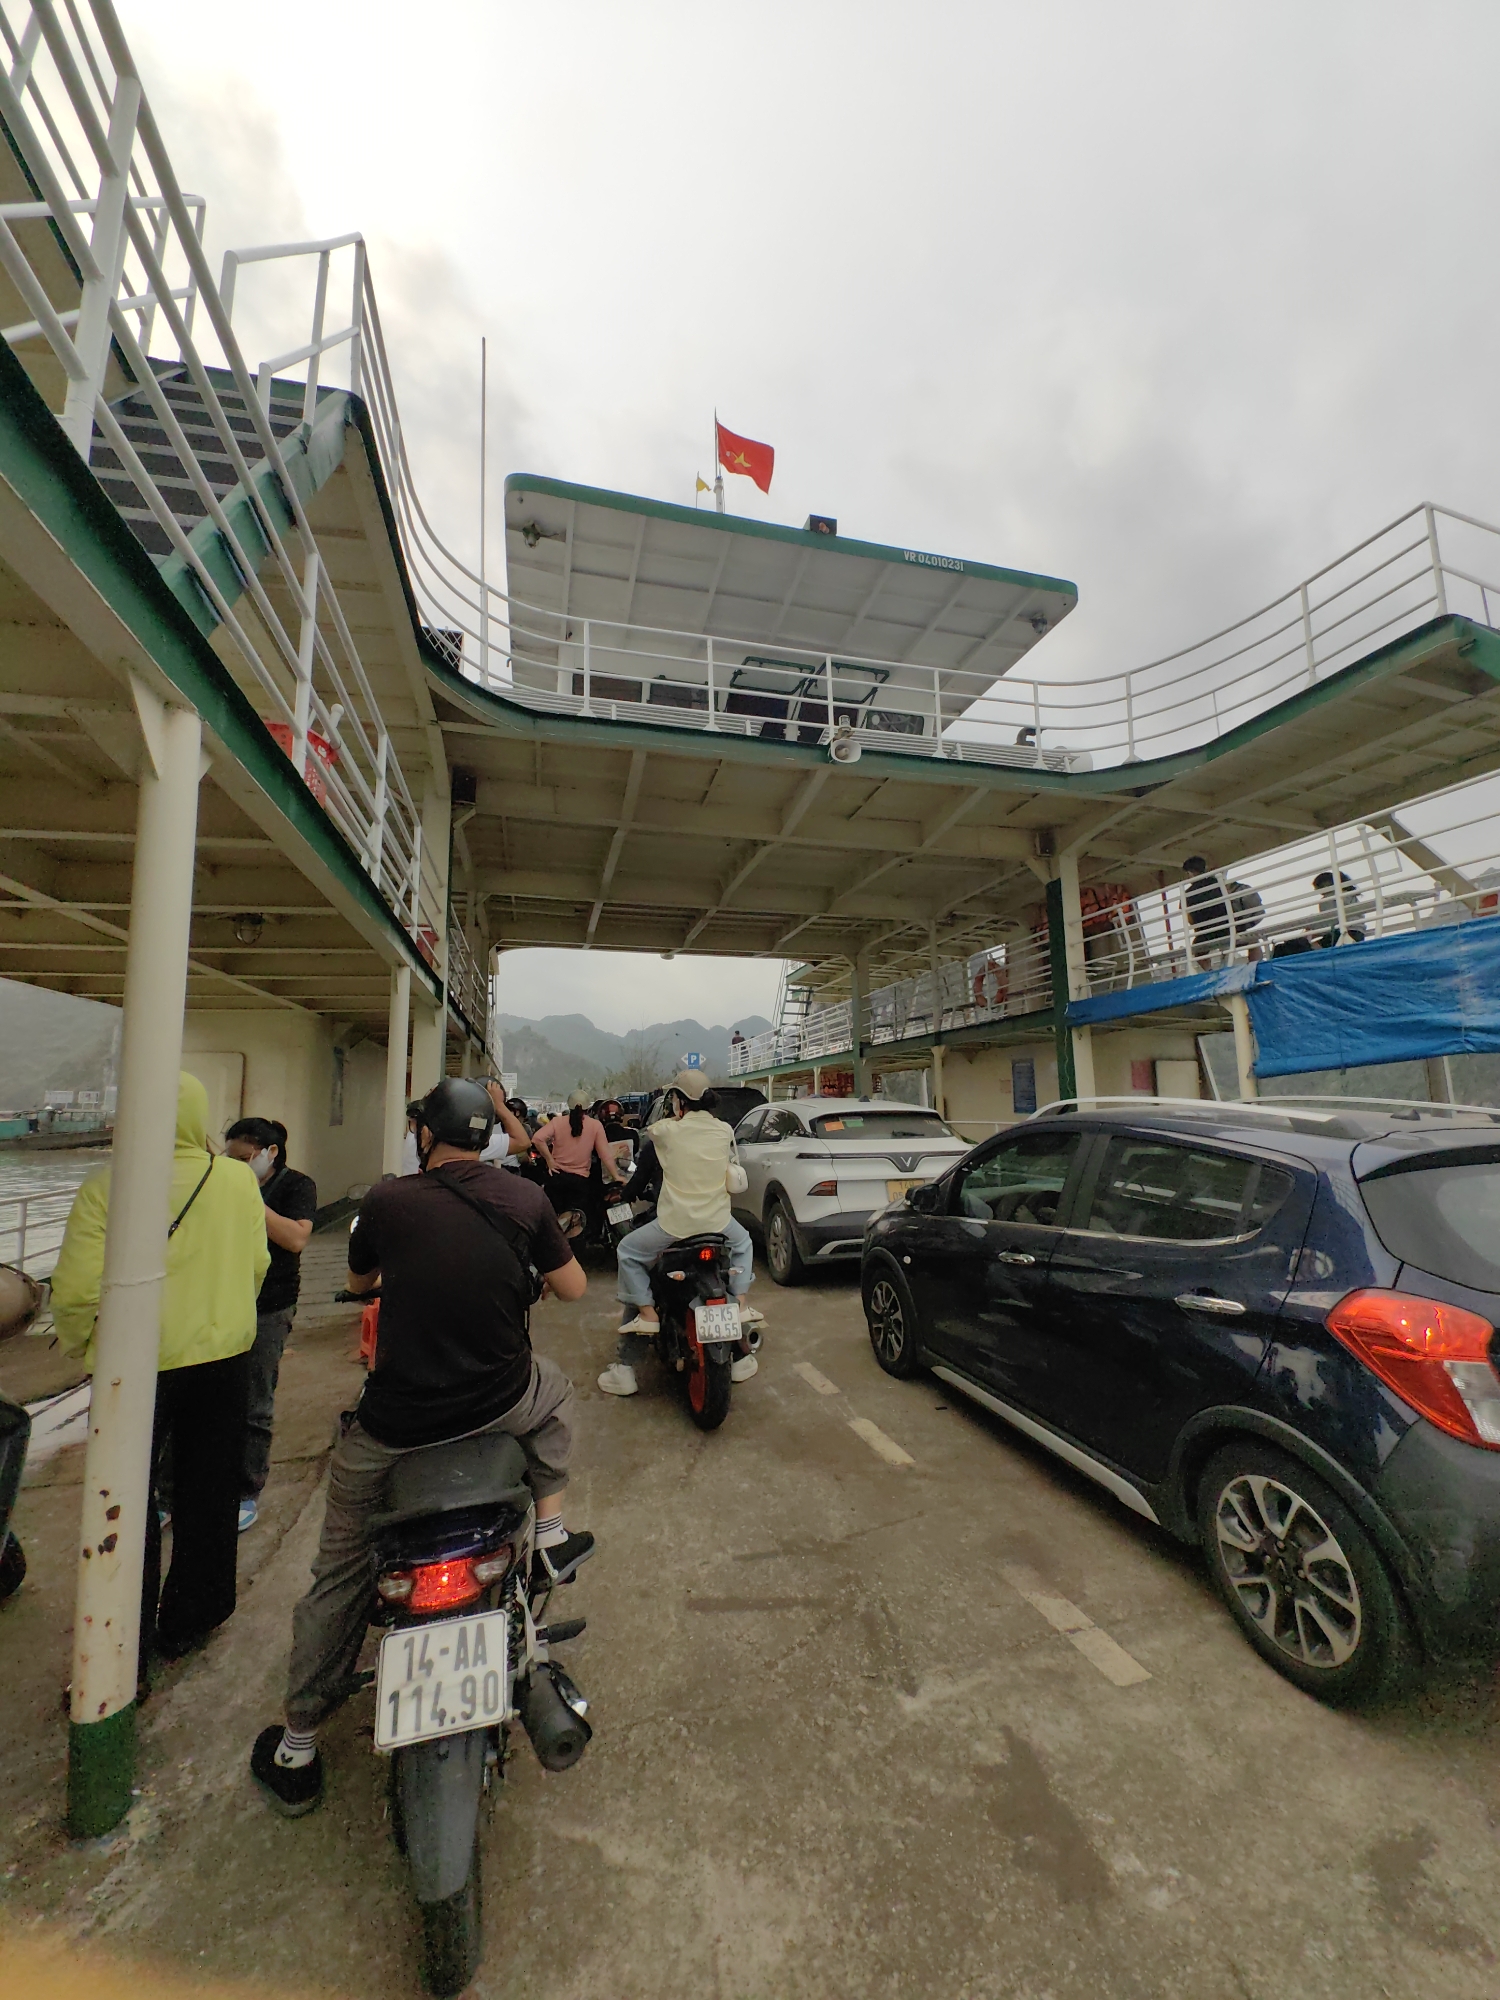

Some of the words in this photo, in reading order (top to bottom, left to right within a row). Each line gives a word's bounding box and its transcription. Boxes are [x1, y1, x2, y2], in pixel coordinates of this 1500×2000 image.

[903, 550, 916, 562] VR
[918, 553, 964, 572] 04010231
[690, 1054, 697, 1064] P
[702, 1306, 733, 1323] 36-K5
[404, 1622, 488, 1682] 14-AA
[388, 1669, 499, 1738] 114.90
